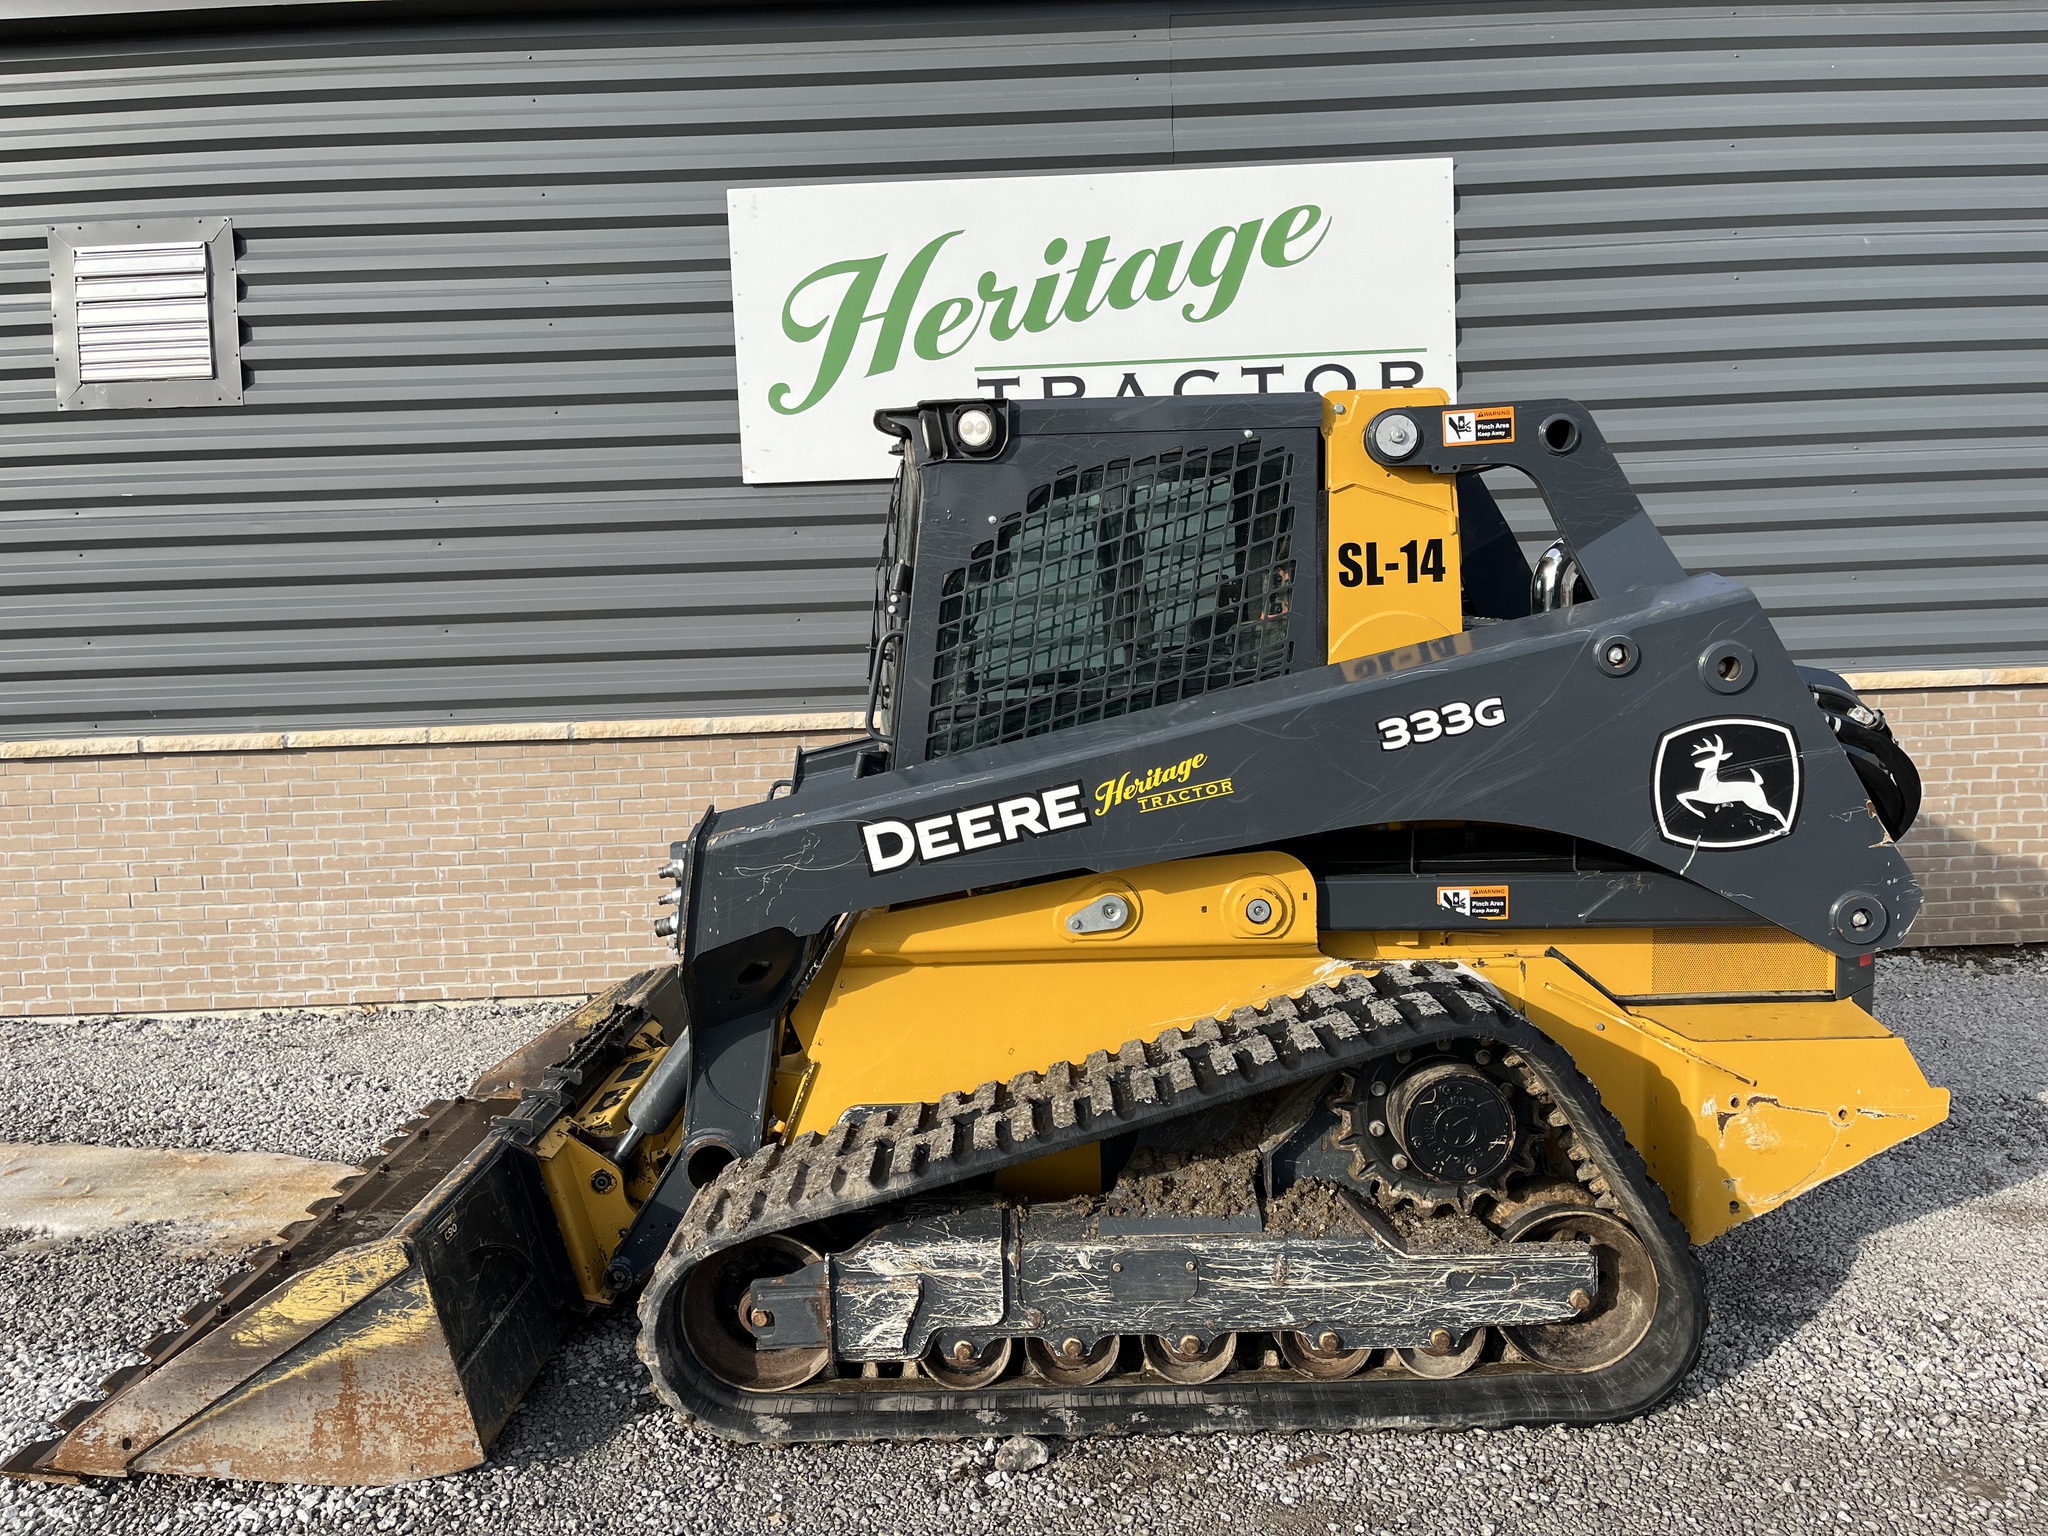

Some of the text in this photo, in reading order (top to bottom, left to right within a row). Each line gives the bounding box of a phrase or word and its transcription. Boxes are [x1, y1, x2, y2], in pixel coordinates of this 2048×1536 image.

[768, 204, 1332, 415] Heritage
[1338, 538, 1446, 588] SL-14
[1379, 697, 1506, 751] 333G
[1094, 753, 1208, 817] Heritage
[1137, 780, 1233, 810] TRACTOR
[863, 785, 1083, 873] DEERE
